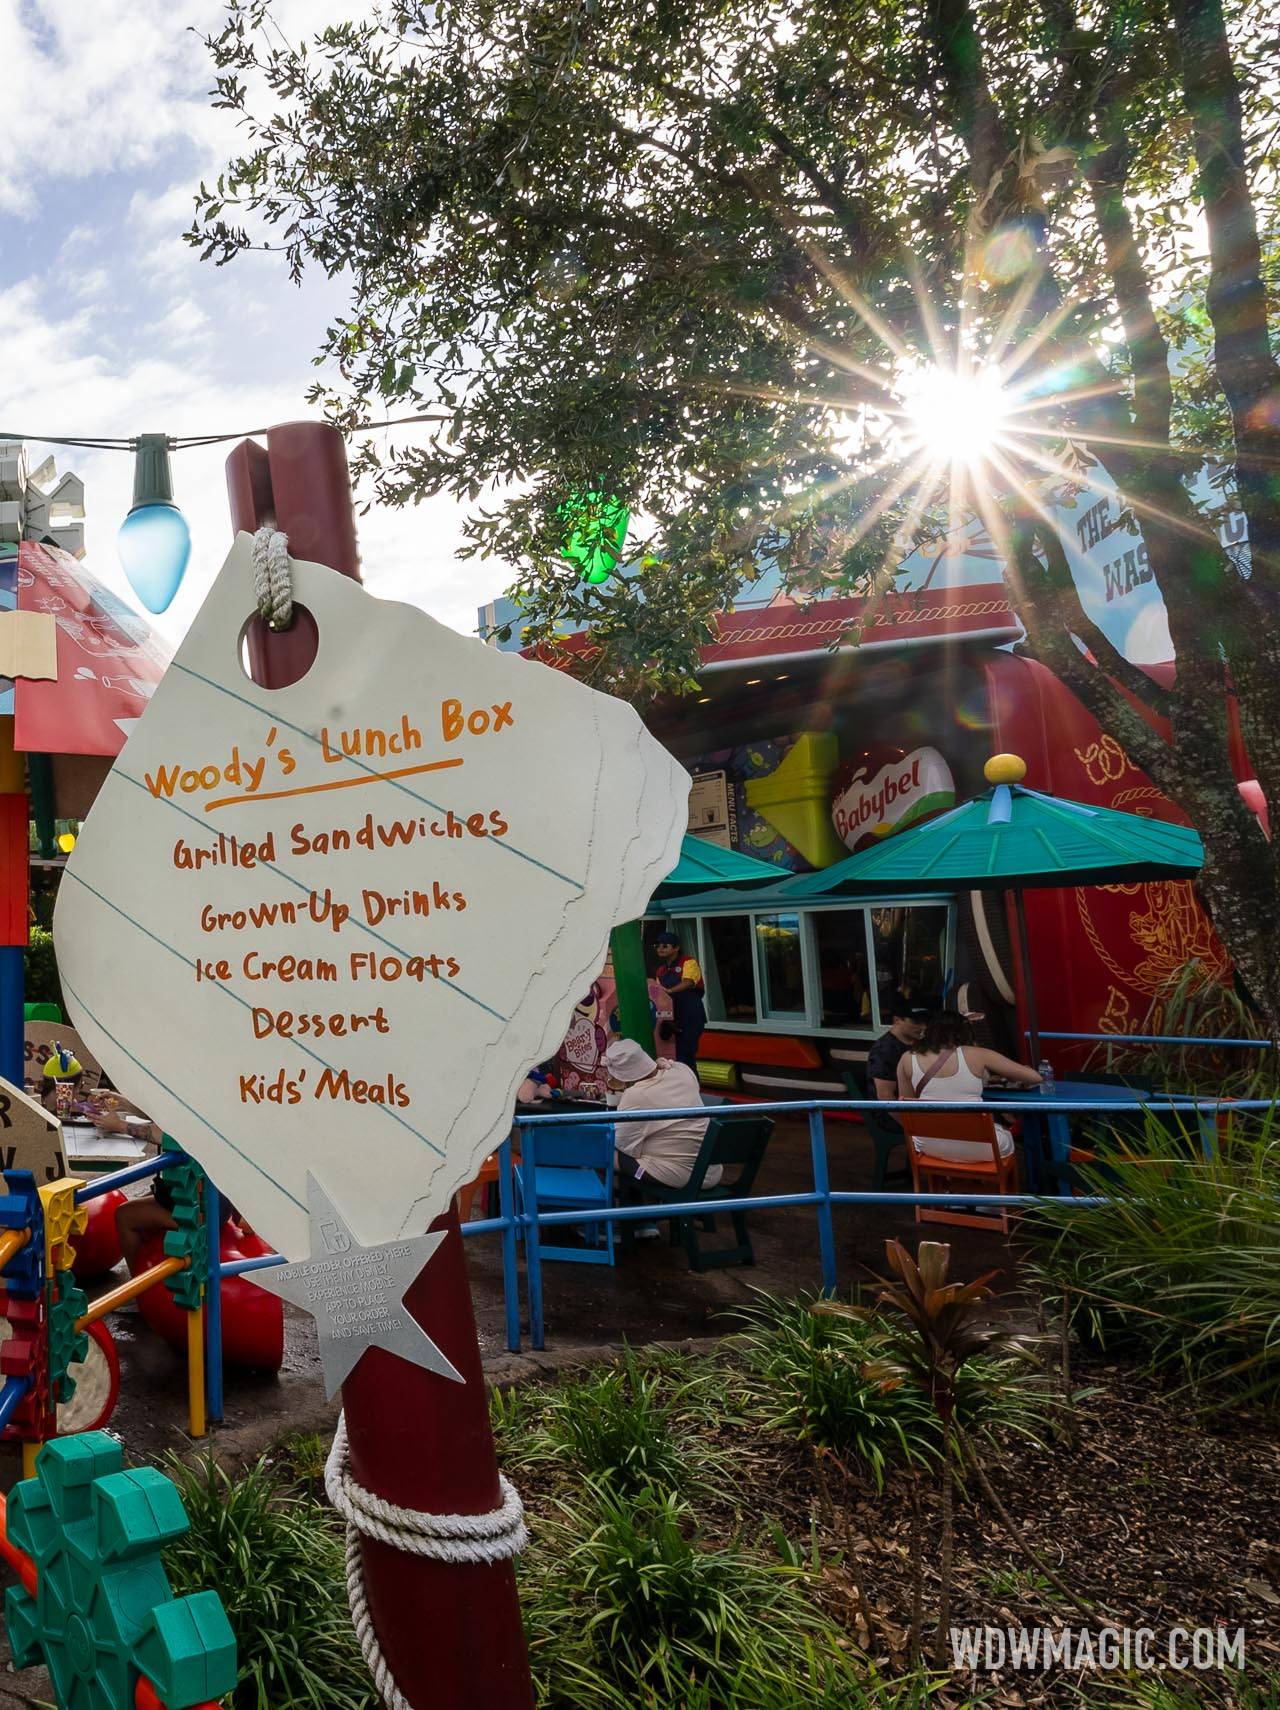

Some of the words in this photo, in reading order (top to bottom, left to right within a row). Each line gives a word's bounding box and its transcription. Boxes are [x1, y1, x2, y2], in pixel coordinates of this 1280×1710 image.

[144, 726, 297, 799] Woody's
[321, 714, 423, 764] Lunch
[441, 698, 515, 744] Box
[727, 783, 737, 811] MENU
[835, 760, 921, 839] Babybel
[173, 832, 277, 870] Grilled
[291, 810, 510, 857] Sandwiches
[729, 814, 739, 842] FACTS
[201, 888, 351, 933] Grown-Up
[362, 881, 468, 928] Drinks
[195, 957, 232, 982] Ice
[242, 951, 338, 982] Cream
[350, 951, 462, 982] Floats
[251, 1007, 391, 1039] Dessert
[566, 1029, 591, 1052] Beary
[573, 1042, 593, 1058] Bites
[238, 1068, 307, 1106] Kids'
[314, 1068, 411, 1108] Meals
[277, 1265, 310, 1281] MOBILE
[310, 1259, 344, 1275] ORDER
[343, 1250, 384, 1268] OFFERED
[303, 1276, 320, 1289] USE
[321, 1271, 341, 1286] THE
[340, 1268, 355, 1282] MY
[355, 1264, 389, 1280] DISNEY
[308, 1283, 360, 1302] EXPERIENCE
[360, 1276, 396, 1293] MOBILE
[326, 1300, 345, 1313] APP
[346, 1297, 358, 1310] TO
[358, 1292, 388, 1308] PLACE
[330, 1312, 358, 1326] YOUR
[358, 1306, 391, 1322] ORDER
[330, 1327, 353, 1340] AND
[352, 1322, 378, 1337] SAVE
[376, 1319, 404, 1334] TIME!
